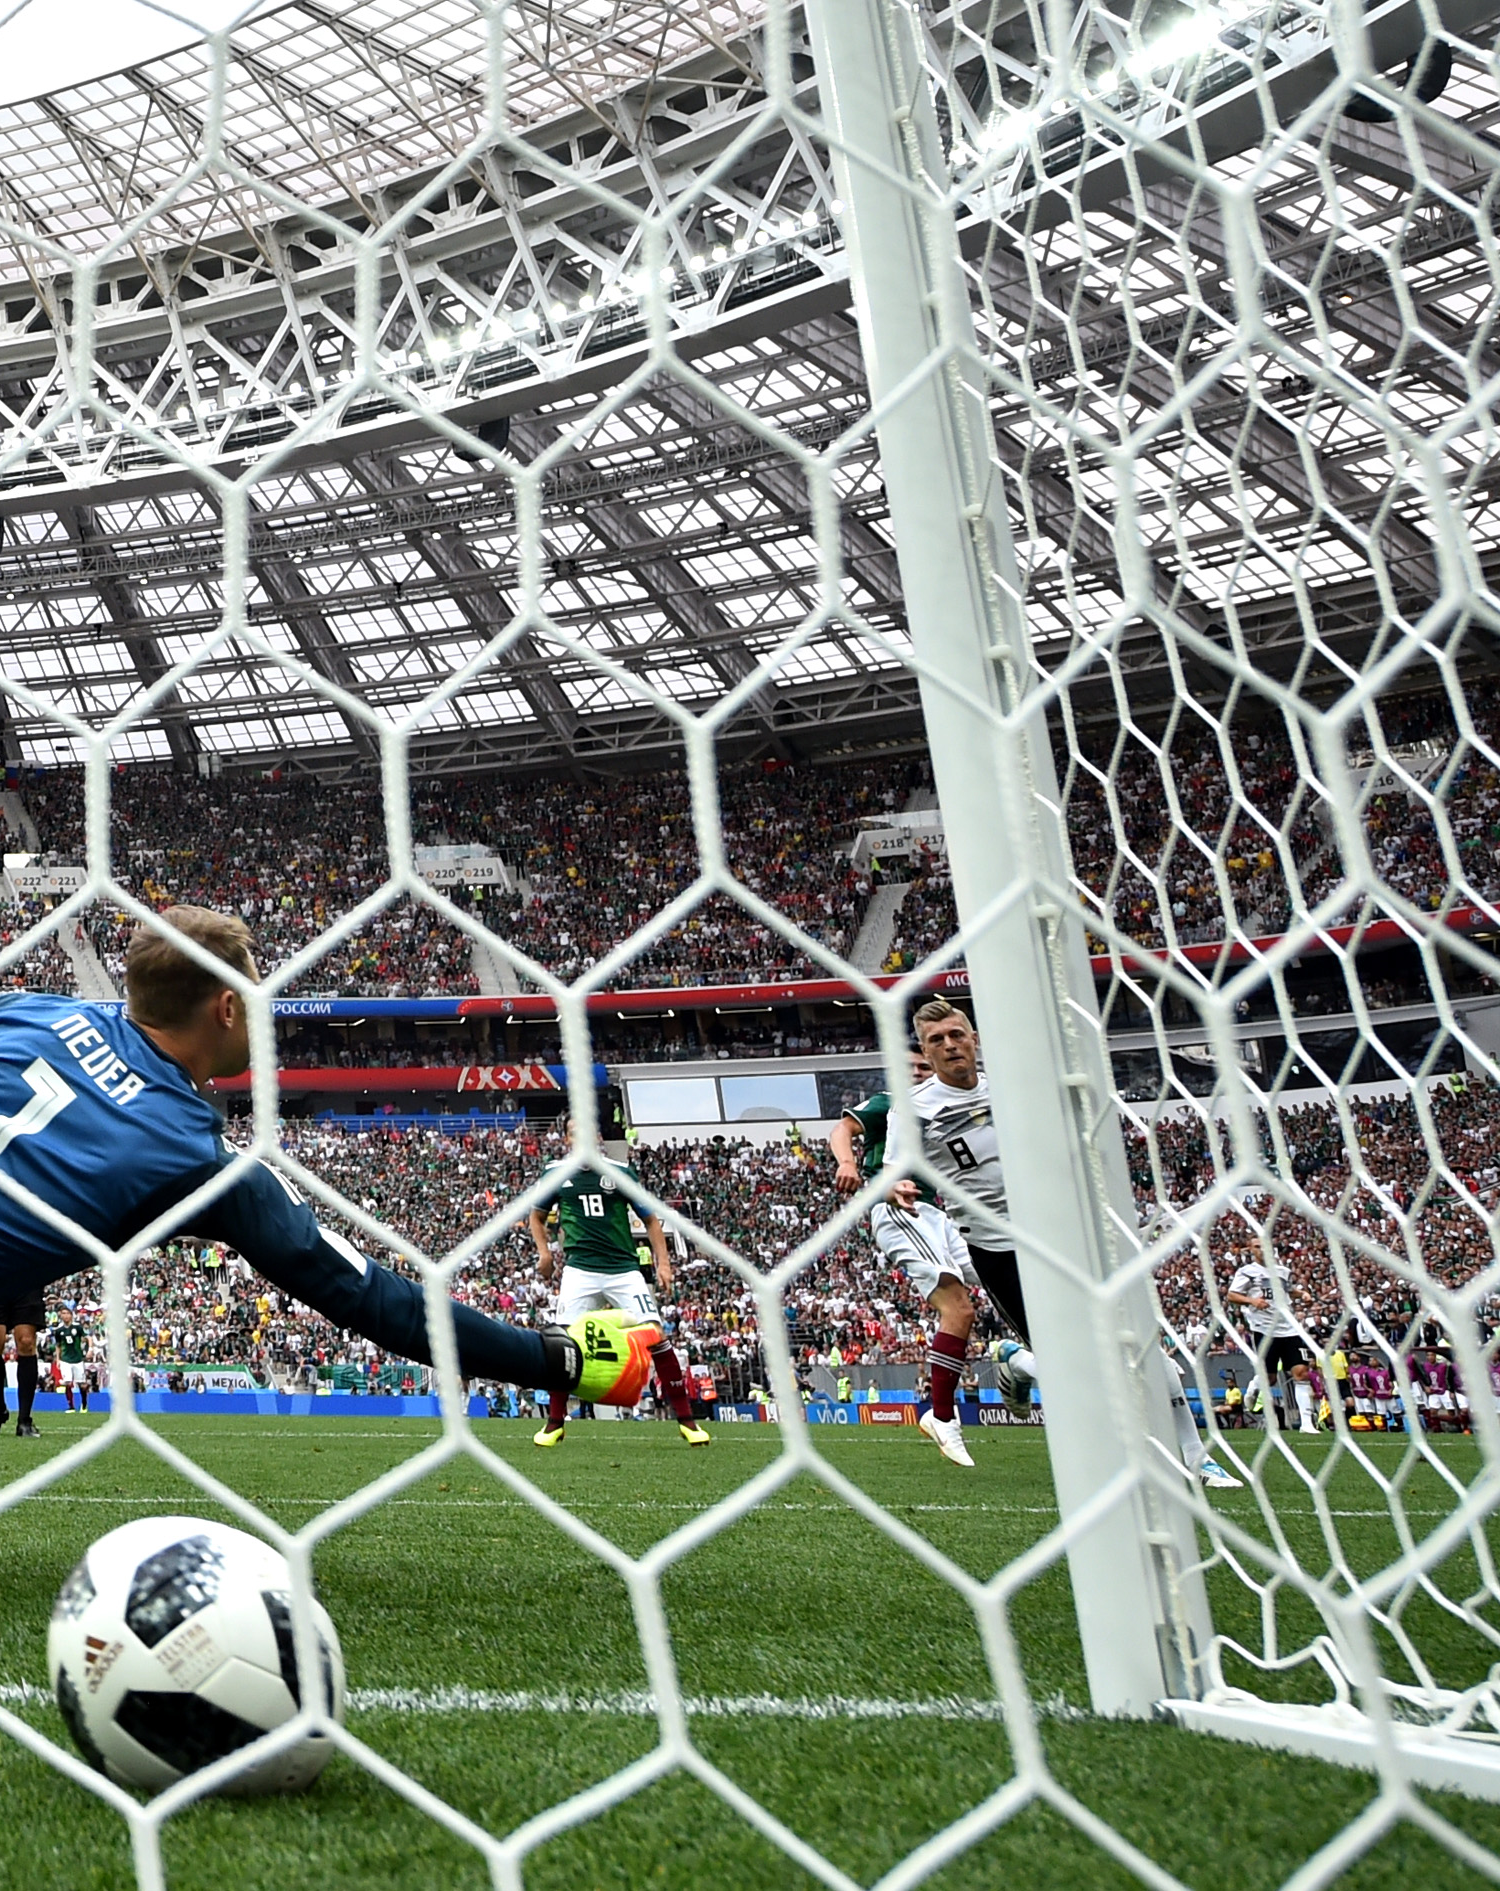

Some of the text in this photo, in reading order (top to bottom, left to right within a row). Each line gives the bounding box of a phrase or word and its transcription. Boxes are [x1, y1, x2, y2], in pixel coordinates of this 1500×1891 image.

[1374, 774, 1395, 788] 16
[881, 834, 945, 849] 218 217
[22, 876, 77, 886] 222 221
[435, 867, 494, 879] 220 219
[272, 1002, 331, 1014] РОССИИ
[51, 1013, 146, 1105] NEUER
[946, 1137, 979, 1171] 8
[578, 1194, 605, 1218] 18
[979, 1408, 1007, 1425] QATAR
[156, 1623, 205, 1665] TELSTAR
[88, 1640, 124, 1694] adidas
